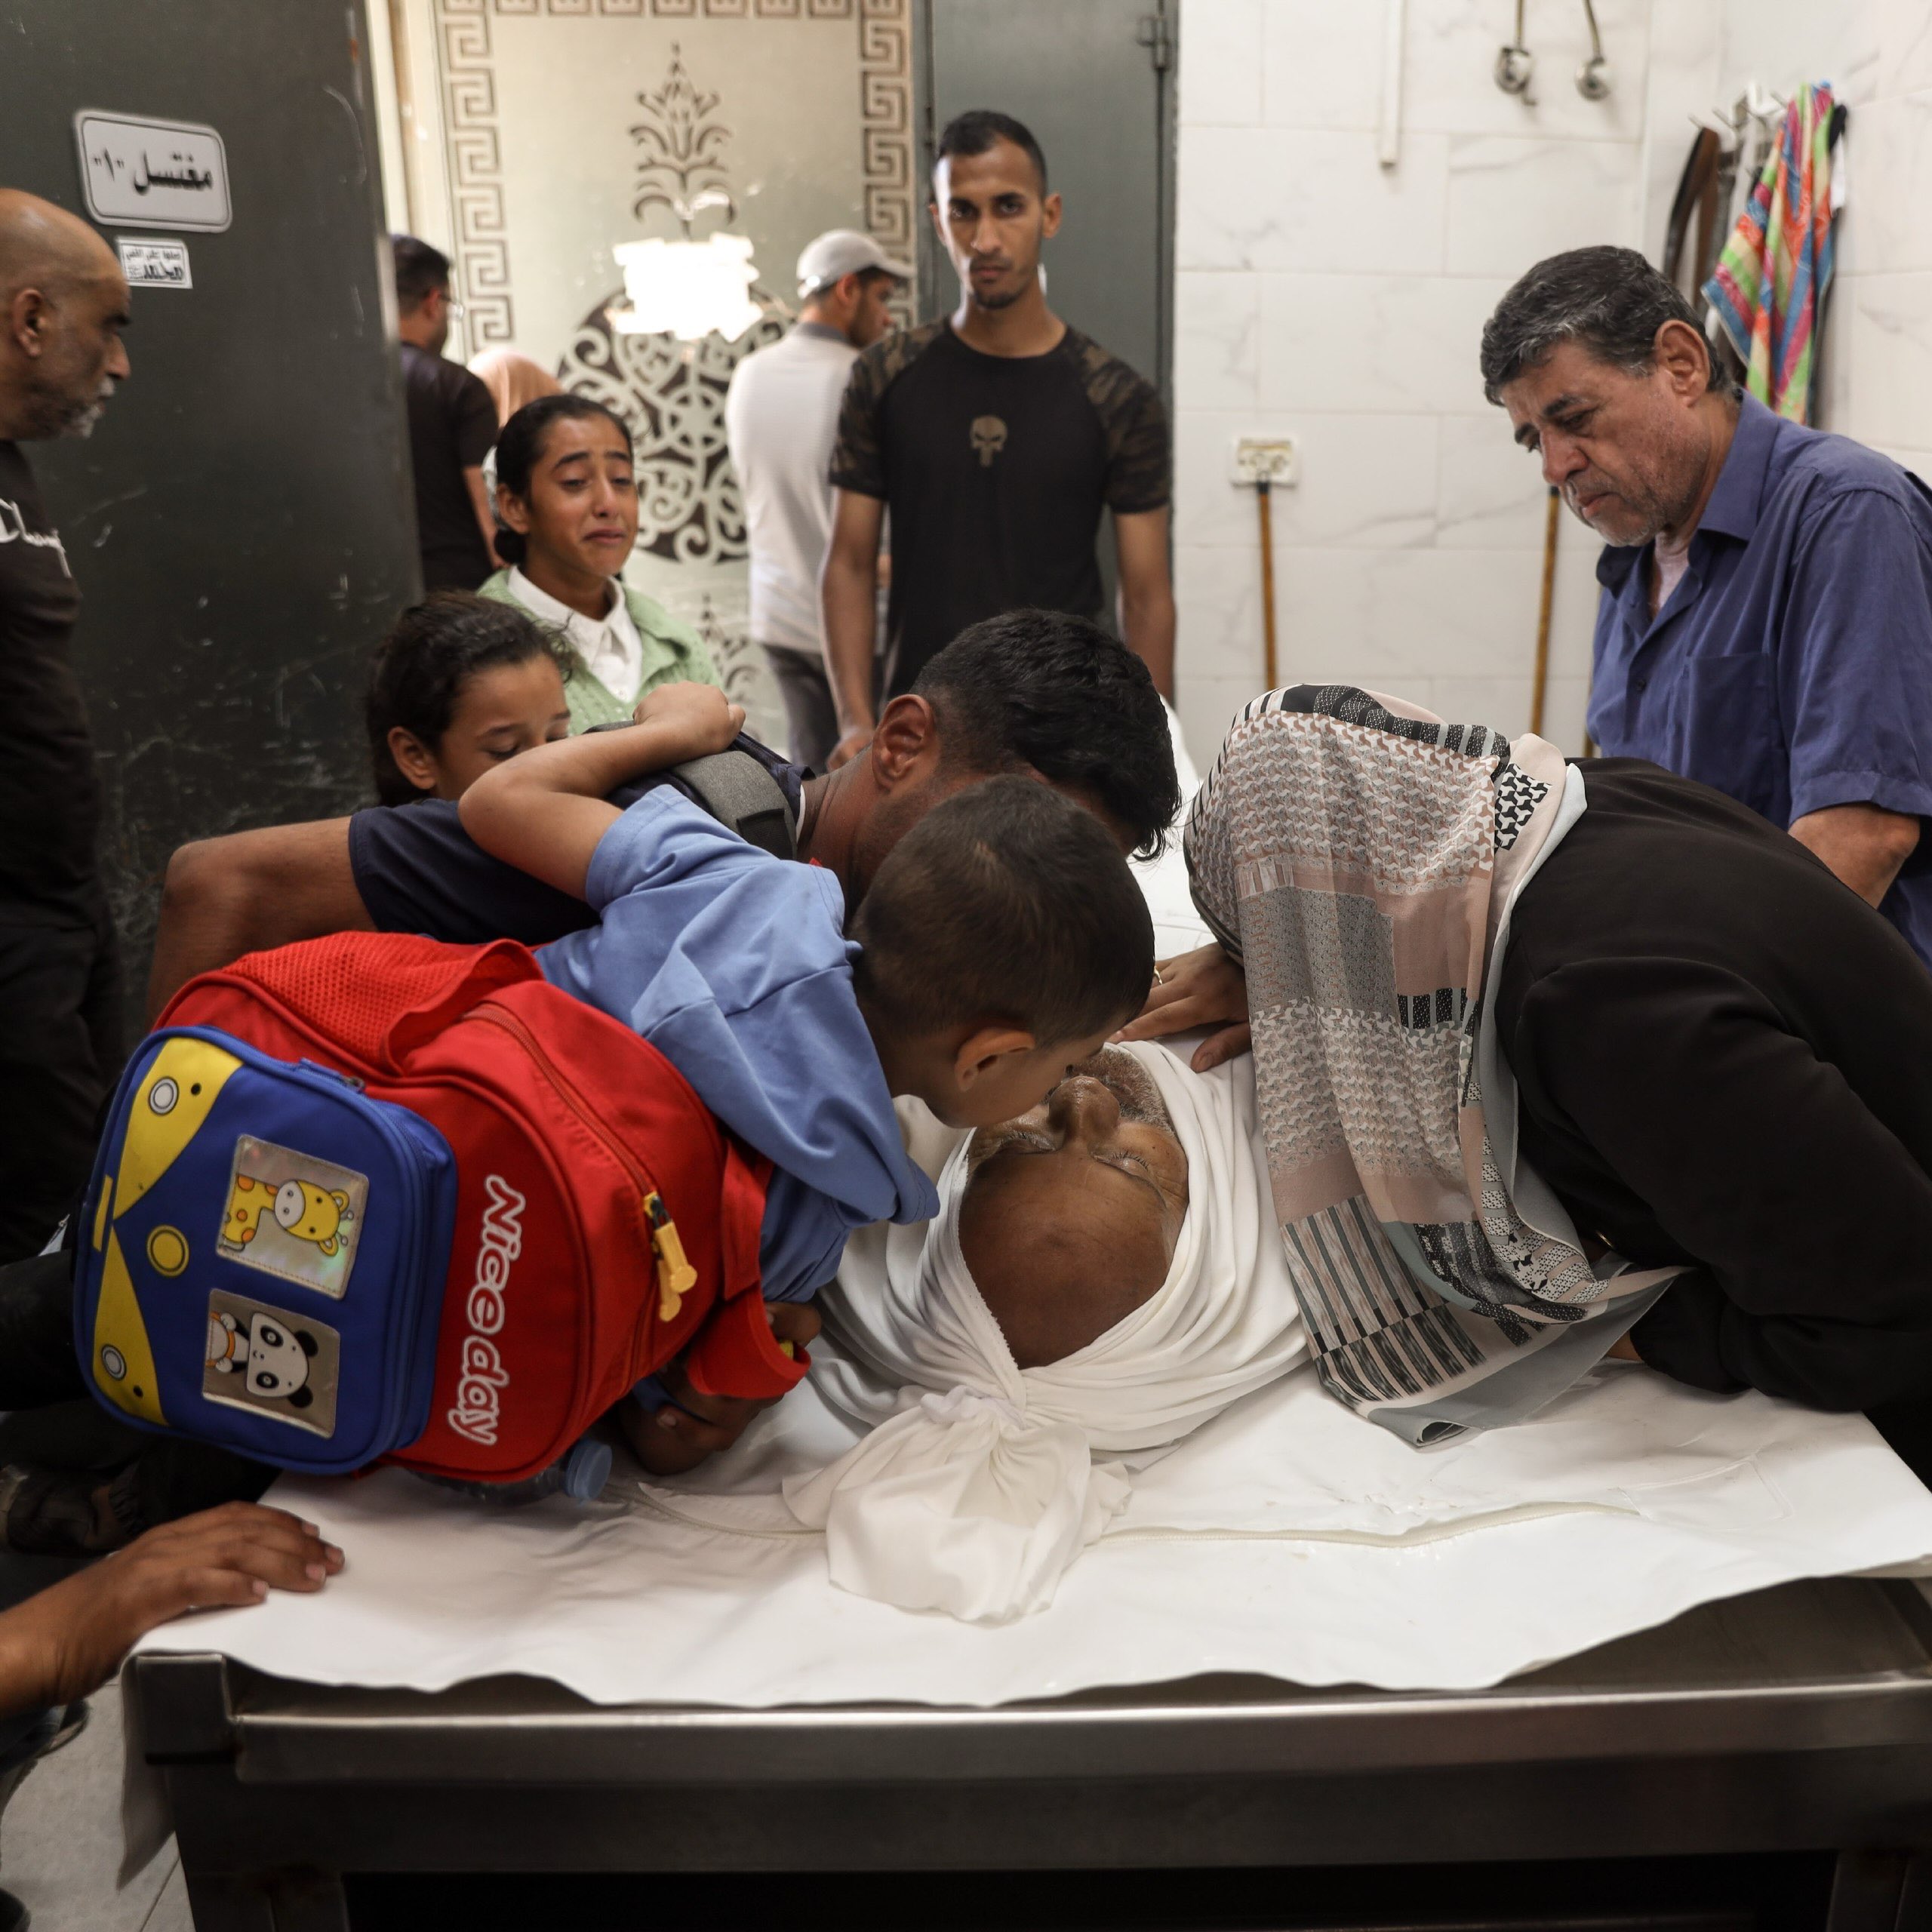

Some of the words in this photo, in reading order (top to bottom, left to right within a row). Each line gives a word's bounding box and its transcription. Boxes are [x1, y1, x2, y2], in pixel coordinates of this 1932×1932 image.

[134, 149, 212, 195] مغتسل
[466, 1174, 527, 1335] Nice
[448, 1334, 510, 1446] day
